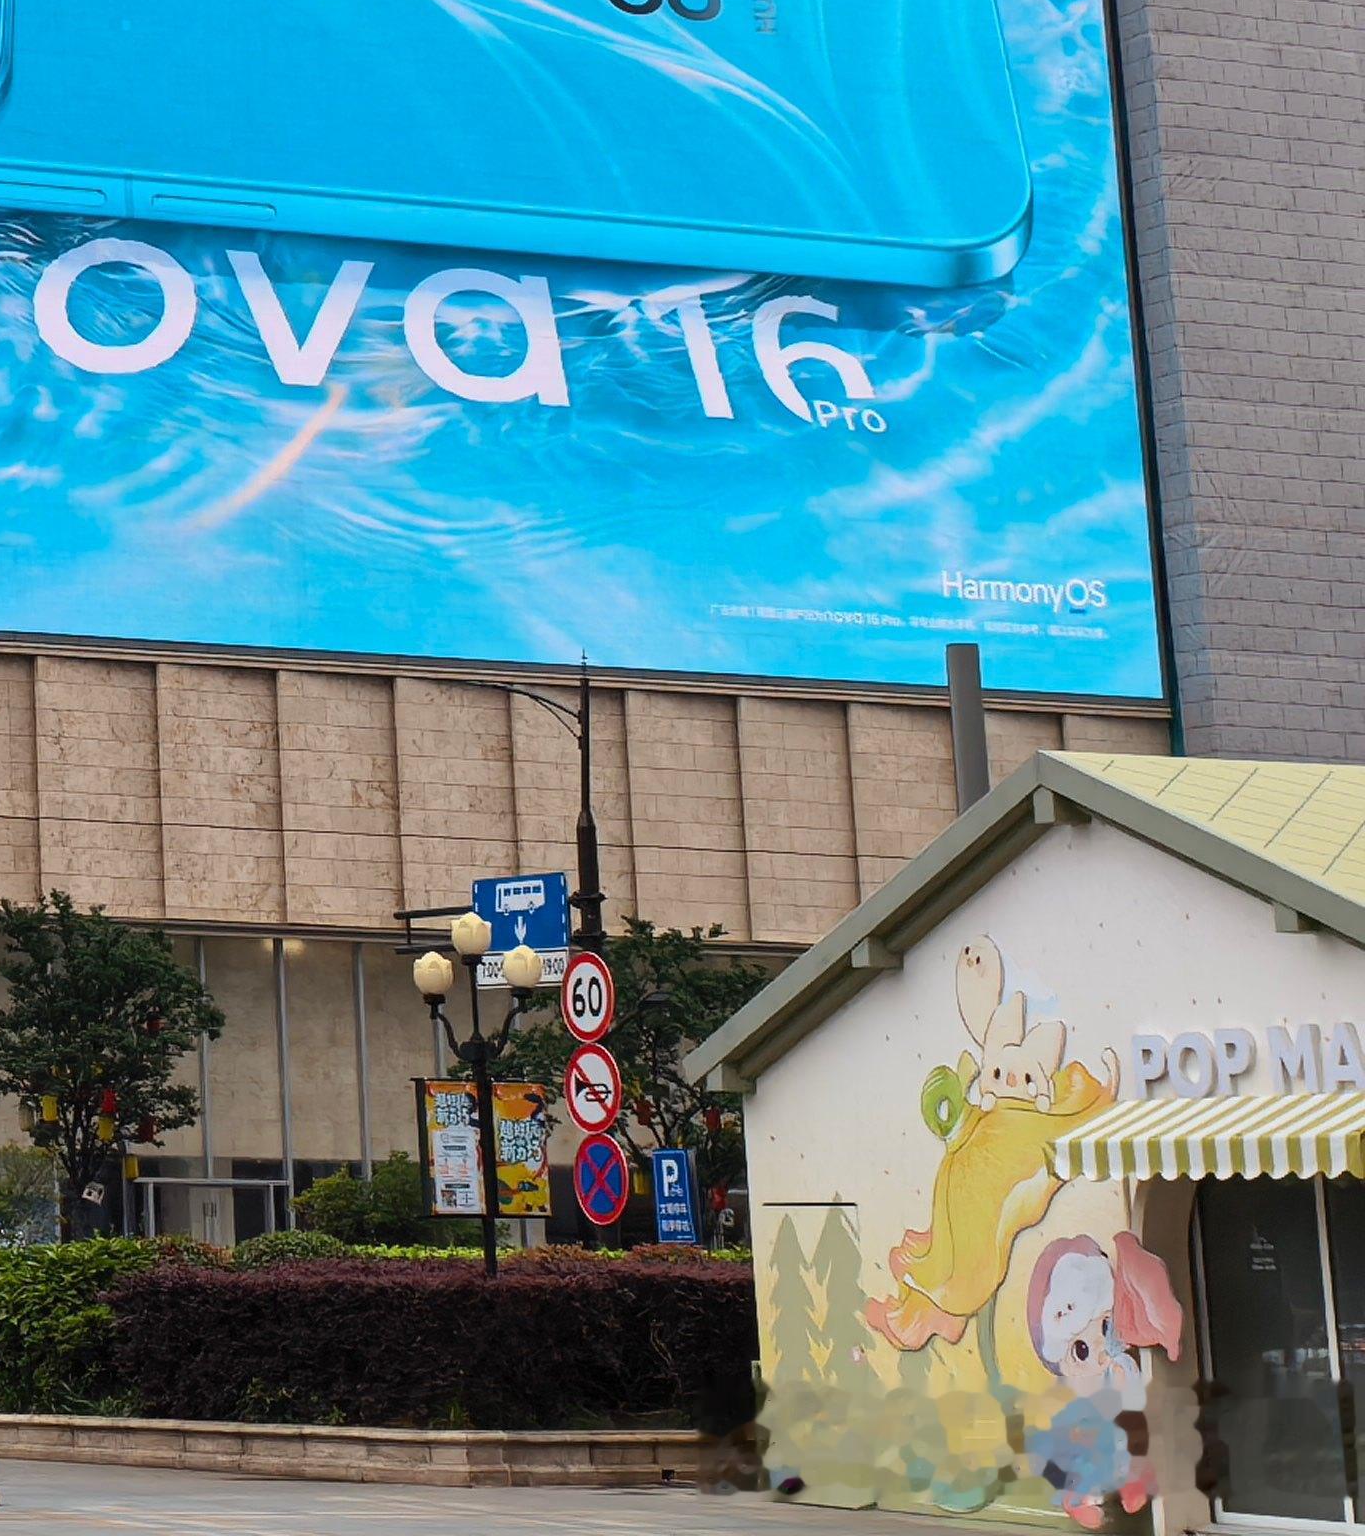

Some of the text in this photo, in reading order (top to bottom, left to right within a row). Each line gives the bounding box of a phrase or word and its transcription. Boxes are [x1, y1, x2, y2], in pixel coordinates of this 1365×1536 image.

[673, 288, 876, 424] 16
[812, 399, 888, 434] Pro
[941, 569, 1107, 613] HarmonyOS
[572, 975, 603, 1018] 60
[1131, 1027, 1257, 1100] POP
[661, 1159, 679, 1198] P
